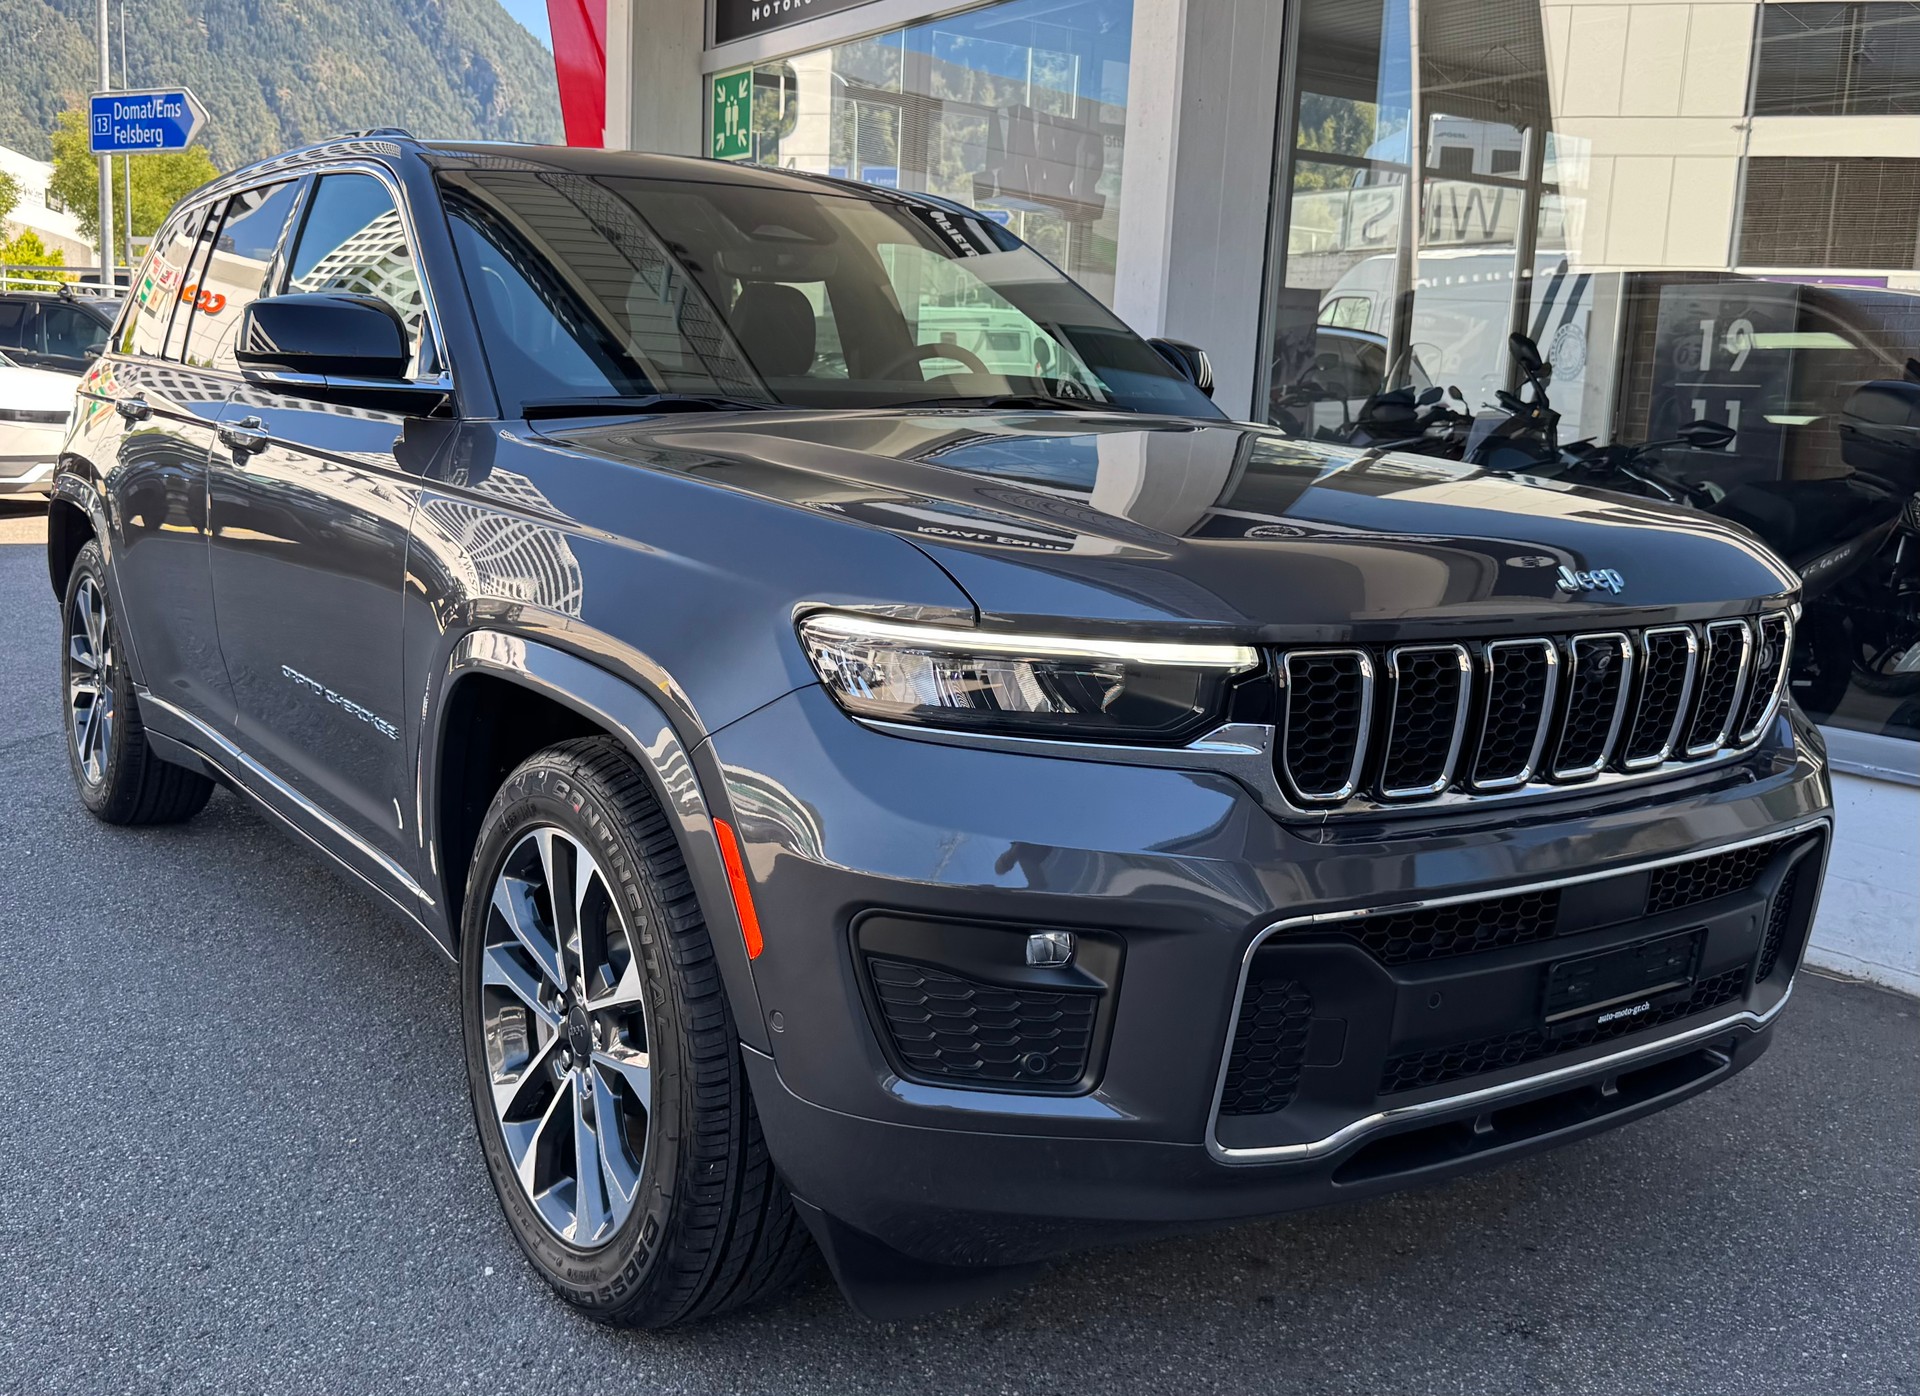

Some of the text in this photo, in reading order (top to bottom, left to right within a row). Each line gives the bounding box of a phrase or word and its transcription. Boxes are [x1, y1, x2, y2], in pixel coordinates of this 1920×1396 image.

[114, 99, 181, 120] Domat/Ems
[97, 117, 108, 133] 13
[114, 123, 164, 147] Felsberg
[1700, 319, 1756, 372] 19
[1555, 564, 1625, 596] Jeep
[552, 779, 670, 1038] CONTINENTAL
[1597, 1001, 1651, 1024] auto-moto-gr.ch
